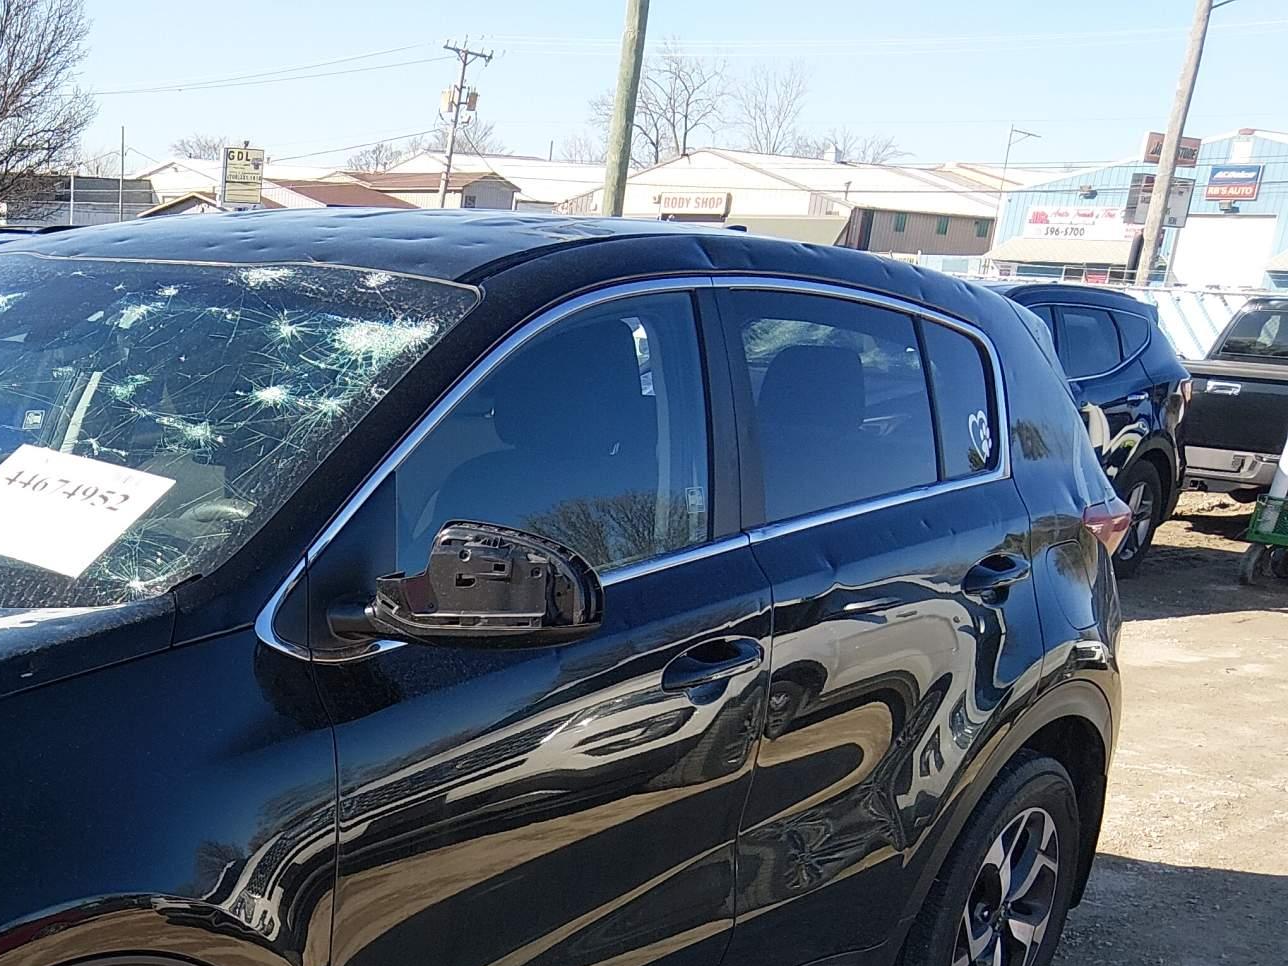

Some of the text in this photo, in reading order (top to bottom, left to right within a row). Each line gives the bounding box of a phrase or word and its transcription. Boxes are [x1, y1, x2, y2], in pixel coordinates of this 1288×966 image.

[228, 150, 251, 161] GDL
[1228, 186, 1253, 196] AUTO
[663, 196, 723, 209] BODY SHOP
[5, 469, 131, 511] 44674952
